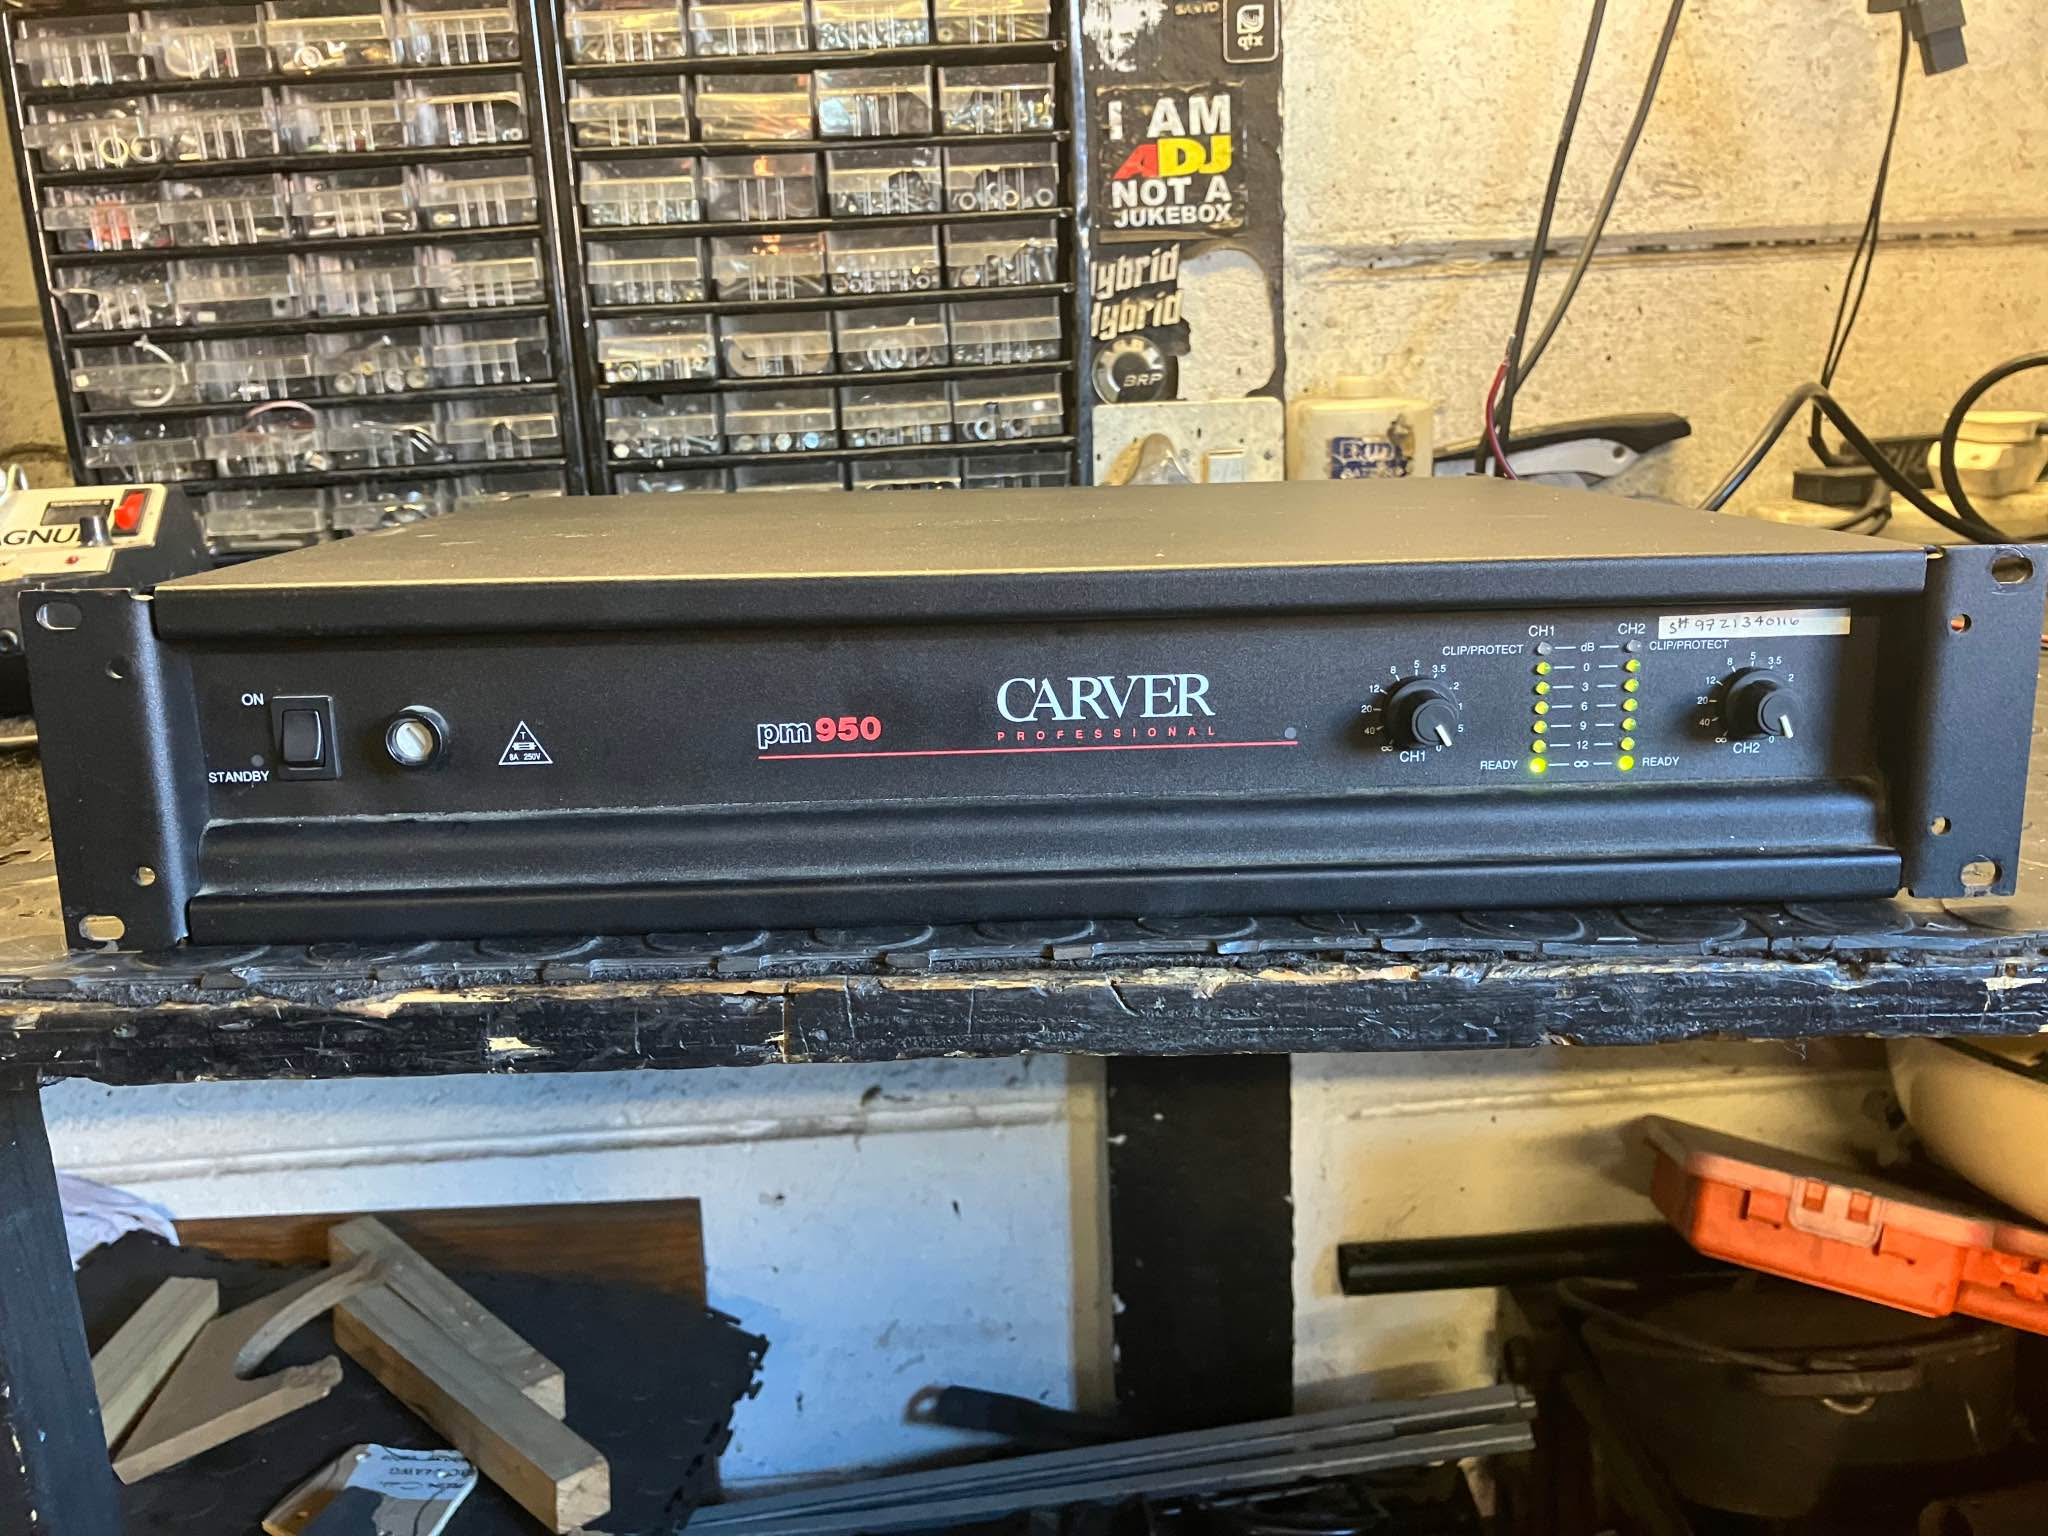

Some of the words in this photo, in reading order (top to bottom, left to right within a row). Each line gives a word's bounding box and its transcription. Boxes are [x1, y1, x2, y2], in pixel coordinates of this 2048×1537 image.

[1174, 2, 1219, 16] SANYO
[1107, 100, 1123, 141] I
[1146, 94, 1232, 138] AM
[1111, 177, 1192, 208] NOT
[1204, 175, 1232, 203] A
[1114, 202, 1233, 228] JUKEBOX
[0, 527, 83, 546] GNU
[1528, 625, 1556, 637] CH1
[1618, 623, 1646, 635] CH2
[1442, 644, 1523, 656] CLIP/PROTECT
[1580, 642, 1595, 652] dB
[1649, 639, 1729, 651] CLIP/PROTECT
[1750, 652, 1757, 661] 5
[1767, 656, 1783, 665] 3.5
[1413, 660, 1420, 669] 5
[1432, 664, 1447, 674] 3.5
[1583, 663, 1590, 672] 0
[1390, 666, 1397, 675] 8
[1706, 676, 1717, 685] 12
[1788, 673, 1795, 682] 2
[1369, 685, 1380, 694] 12
[1453, 681, 1460, 690] 2
[1582, 682, 1589, 692] 3
[241, 693, 264, 706] ON
[996, 673, 1216, 723] CARVER
[1697, 696, 1709, 705] 20
[1361, 704, 1373, 713] 20
[1580, 702, 1588, 711] 6
[1579, 721, 1587, 731] 9
[1699, 718, 1711, 727] 40
[519, 731, 527, 740] T
[997, 726, 1216, 741] PROFESSIONAL
[1364, 726, 1376, 735] 40
[1576, 740, 1589, 750] 12
[1732, 743, 1761, 755] CH2
[1399, 751, 1426, 763] CH1
[1642, 757, 1680, 767] READY
[1479, 760, 1518, 771] READY
[208, 771, 270, 783] STANDBY
